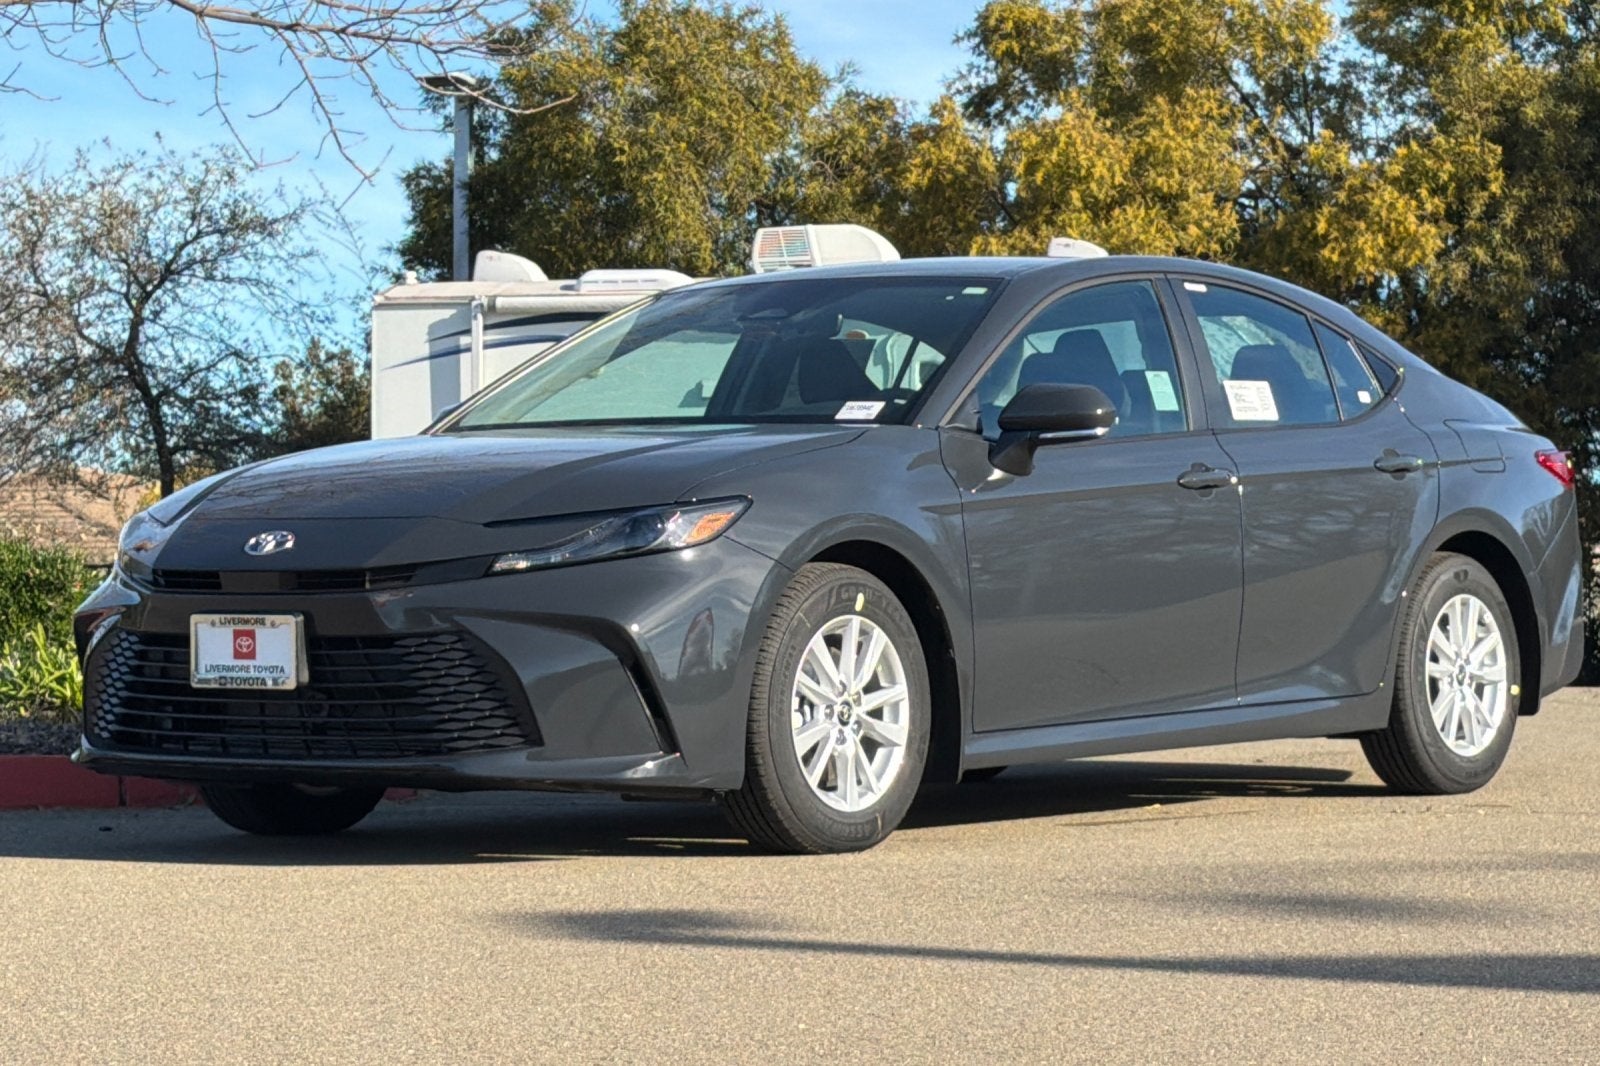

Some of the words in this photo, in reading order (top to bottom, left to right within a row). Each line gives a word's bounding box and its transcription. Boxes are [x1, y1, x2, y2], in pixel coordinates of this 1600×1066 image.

[219, 616, 266, 626] LIVERMORE
[205, 664, 251, 673] LIVERMORE
[253, 665, 285, 674] TOYOTA
[229, 676, 268, 687] TOYOTA
